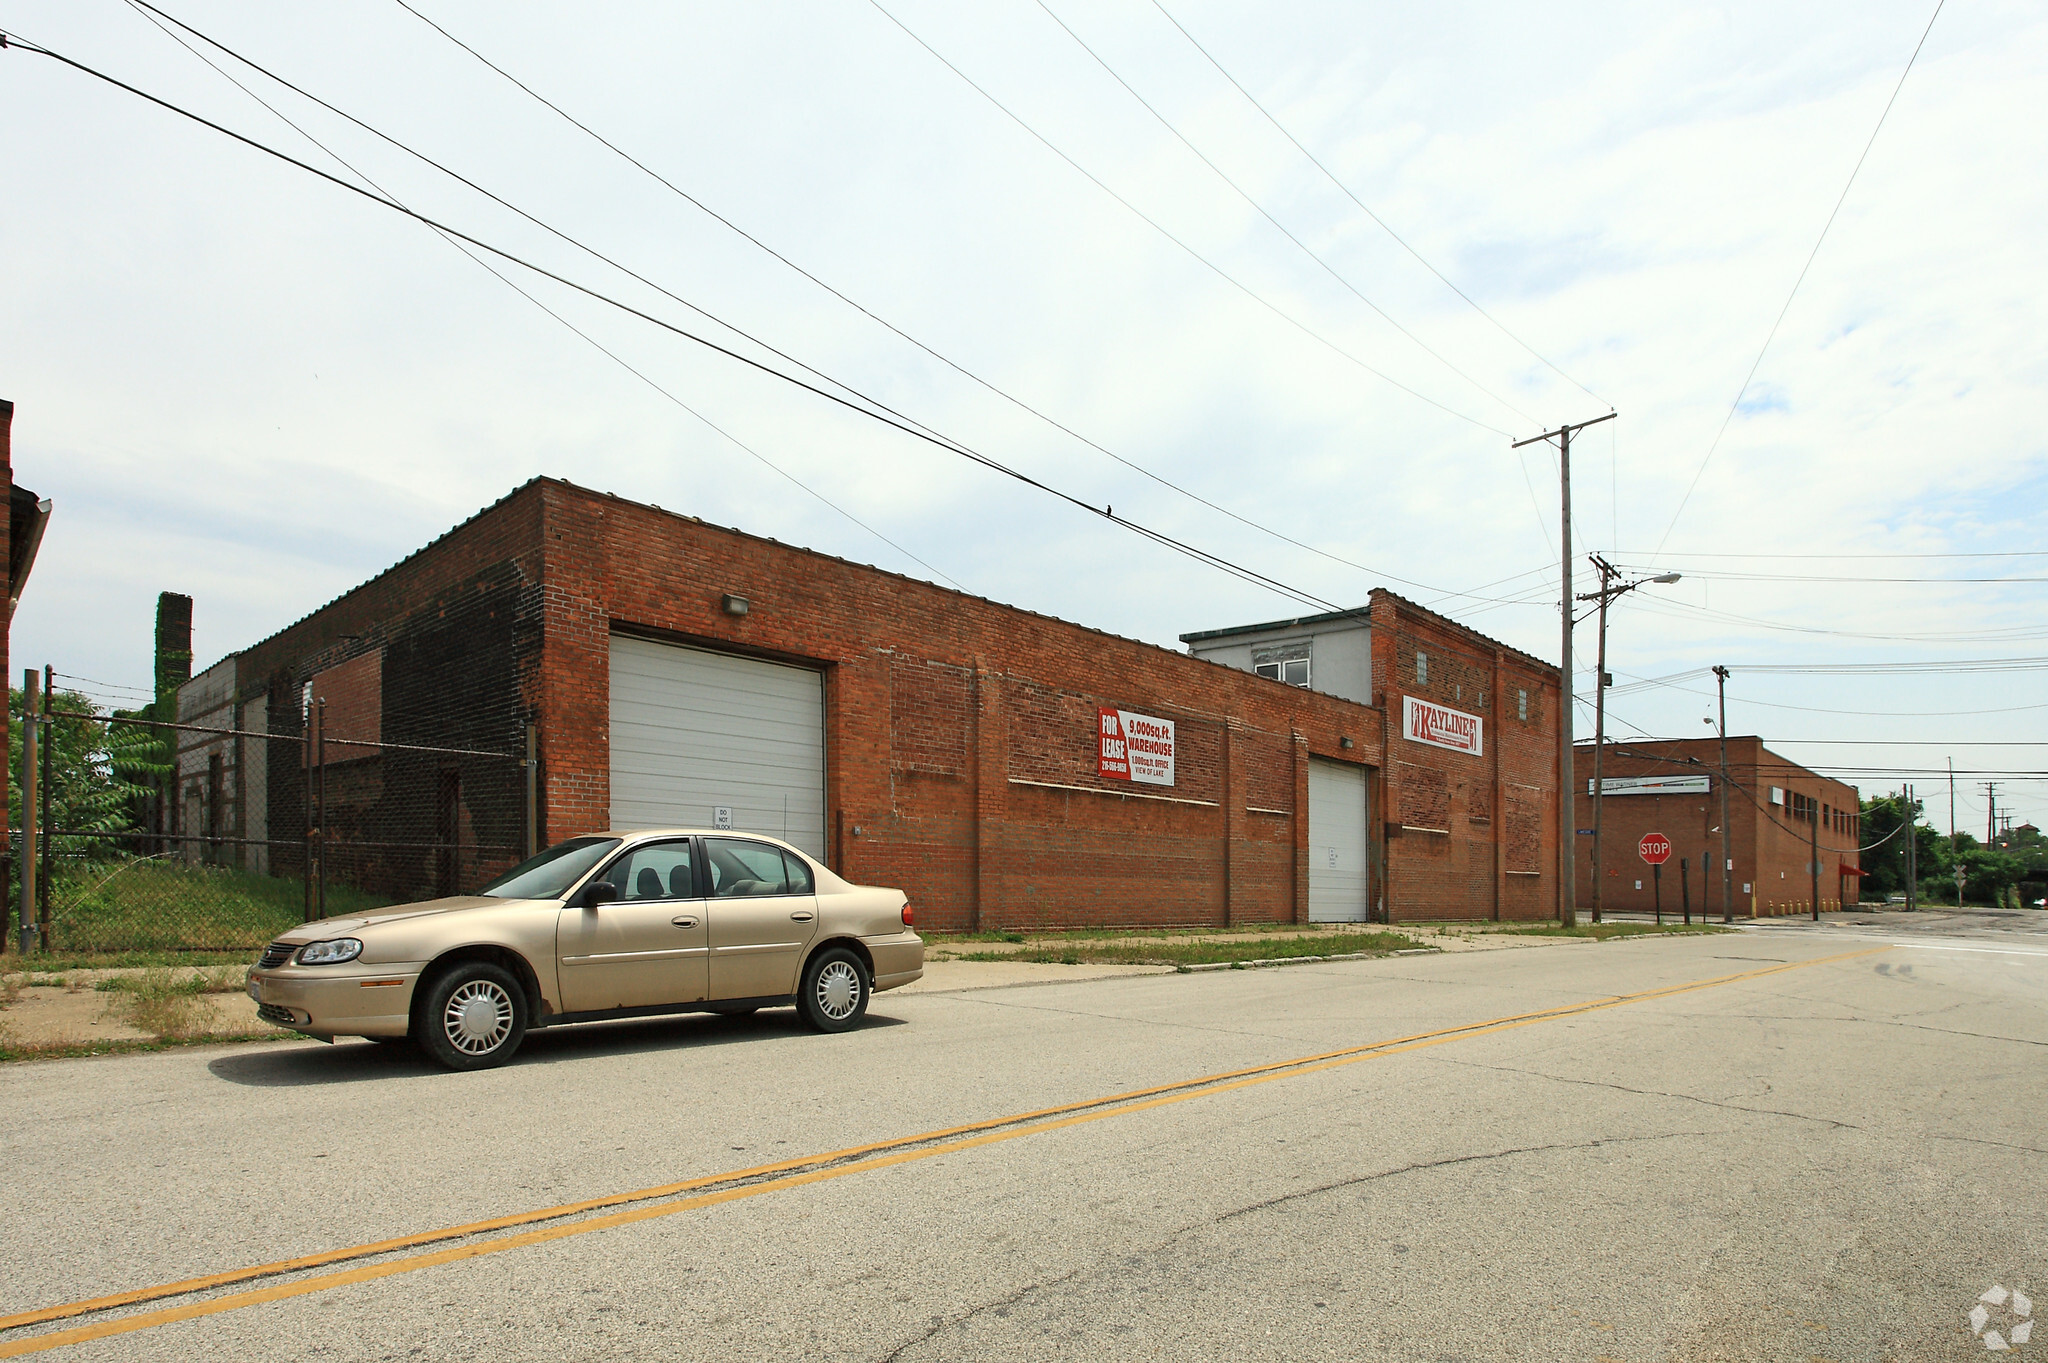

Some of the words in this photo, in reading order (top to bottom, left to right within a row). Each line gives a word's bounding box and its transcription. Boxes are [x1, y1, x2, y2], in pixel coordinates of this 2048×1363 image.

[1102, 715, 1117, 735] FOR
[1420, 704, 1469, 740] KAYLINE
[1102, 738, 1125, 759] LEASE
[1129, 737, 1172, 756] WAREHOUSE
[1147, 768, 1153, 776] OF
[1153, 769, 1164, 777] LAKE
[1155, 759, 1169, 769] OFFICE
[1641, 842, 1669, 855] STOP
